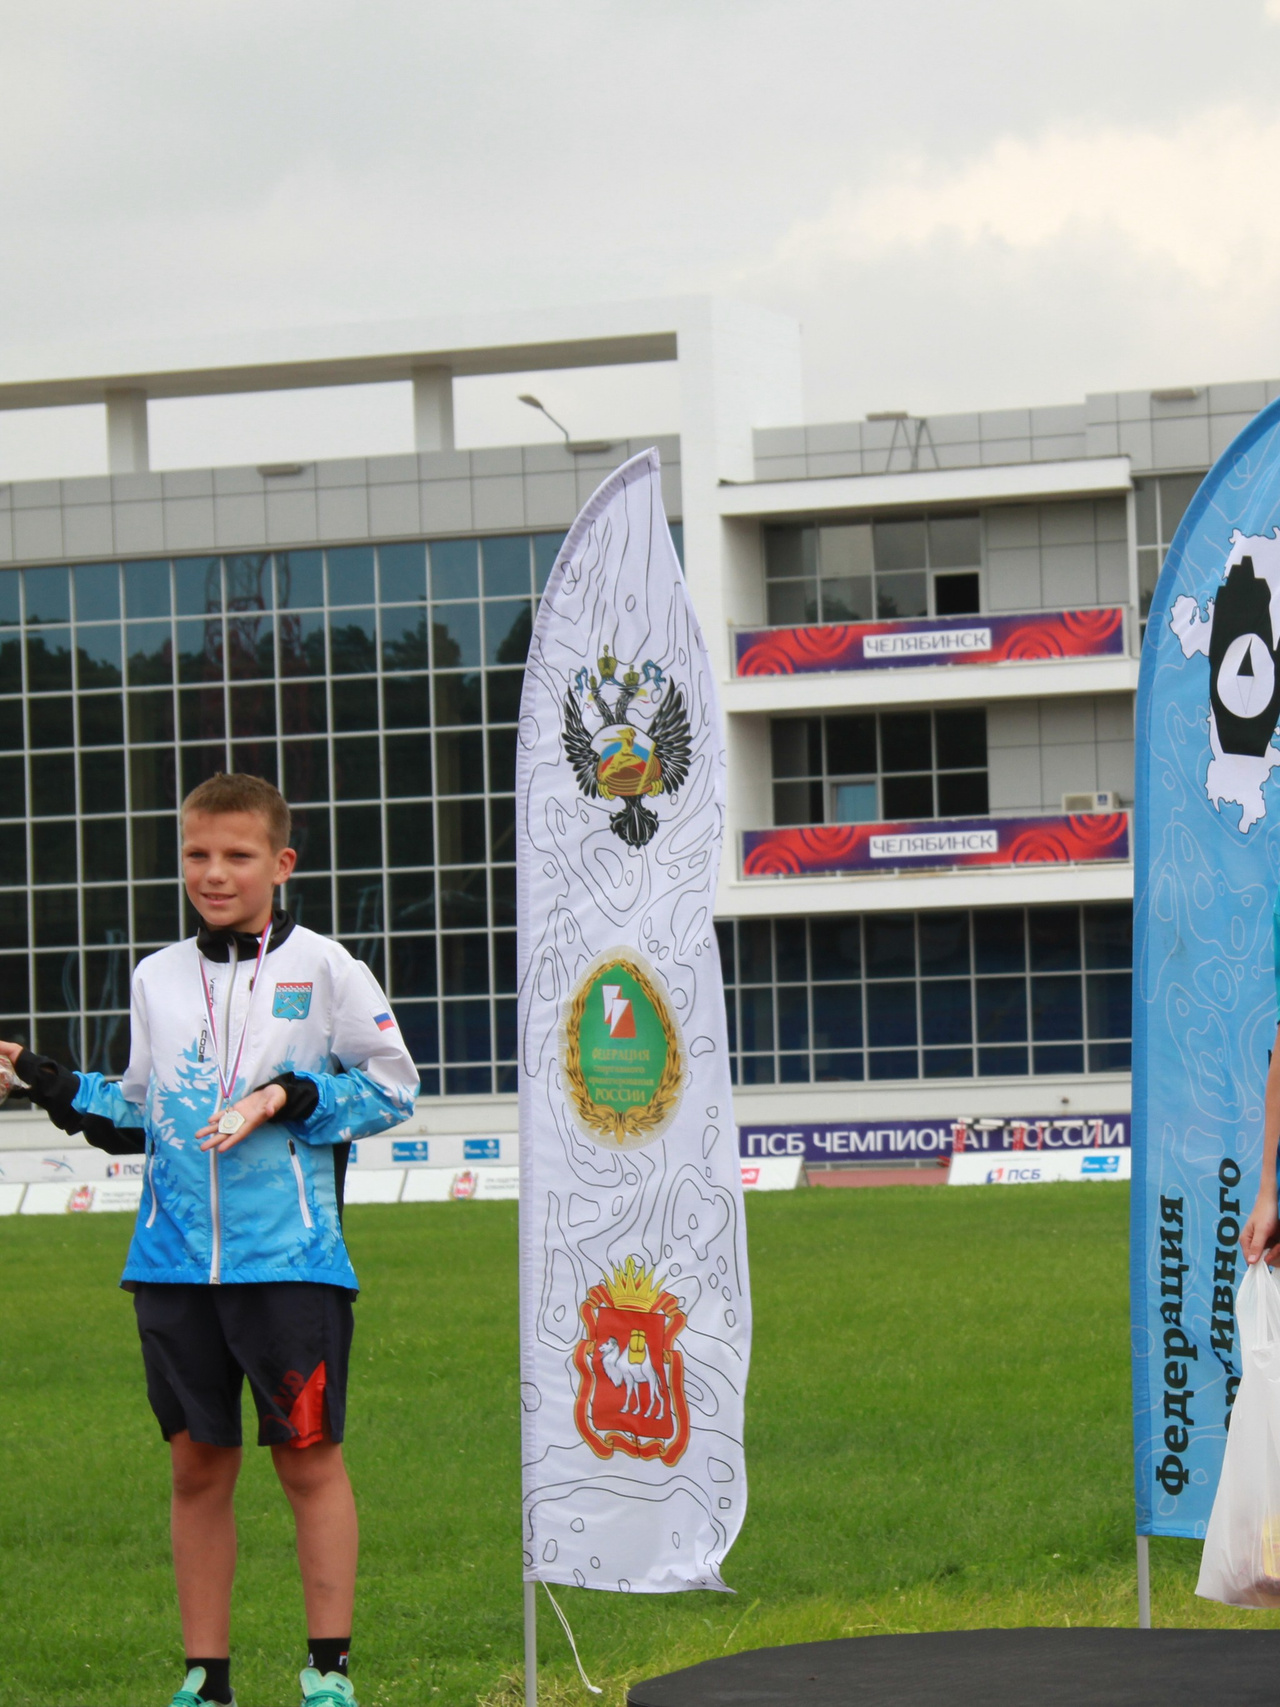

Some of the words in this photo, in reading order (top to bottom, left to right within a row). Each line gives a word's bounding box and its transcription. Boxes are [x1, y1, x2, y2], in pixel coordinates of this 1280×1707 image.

[865, 631, 989, 654] ЧЕЛЯБИНСК
[872, 834, 995, 855] ЧЕЛЯБИНСК
[747, 1131, 806, 1156] ПСБ
[1007, 1168, 1042, 1182] ПСБ
[1155, 1194, 1198, 1496] Федерация
